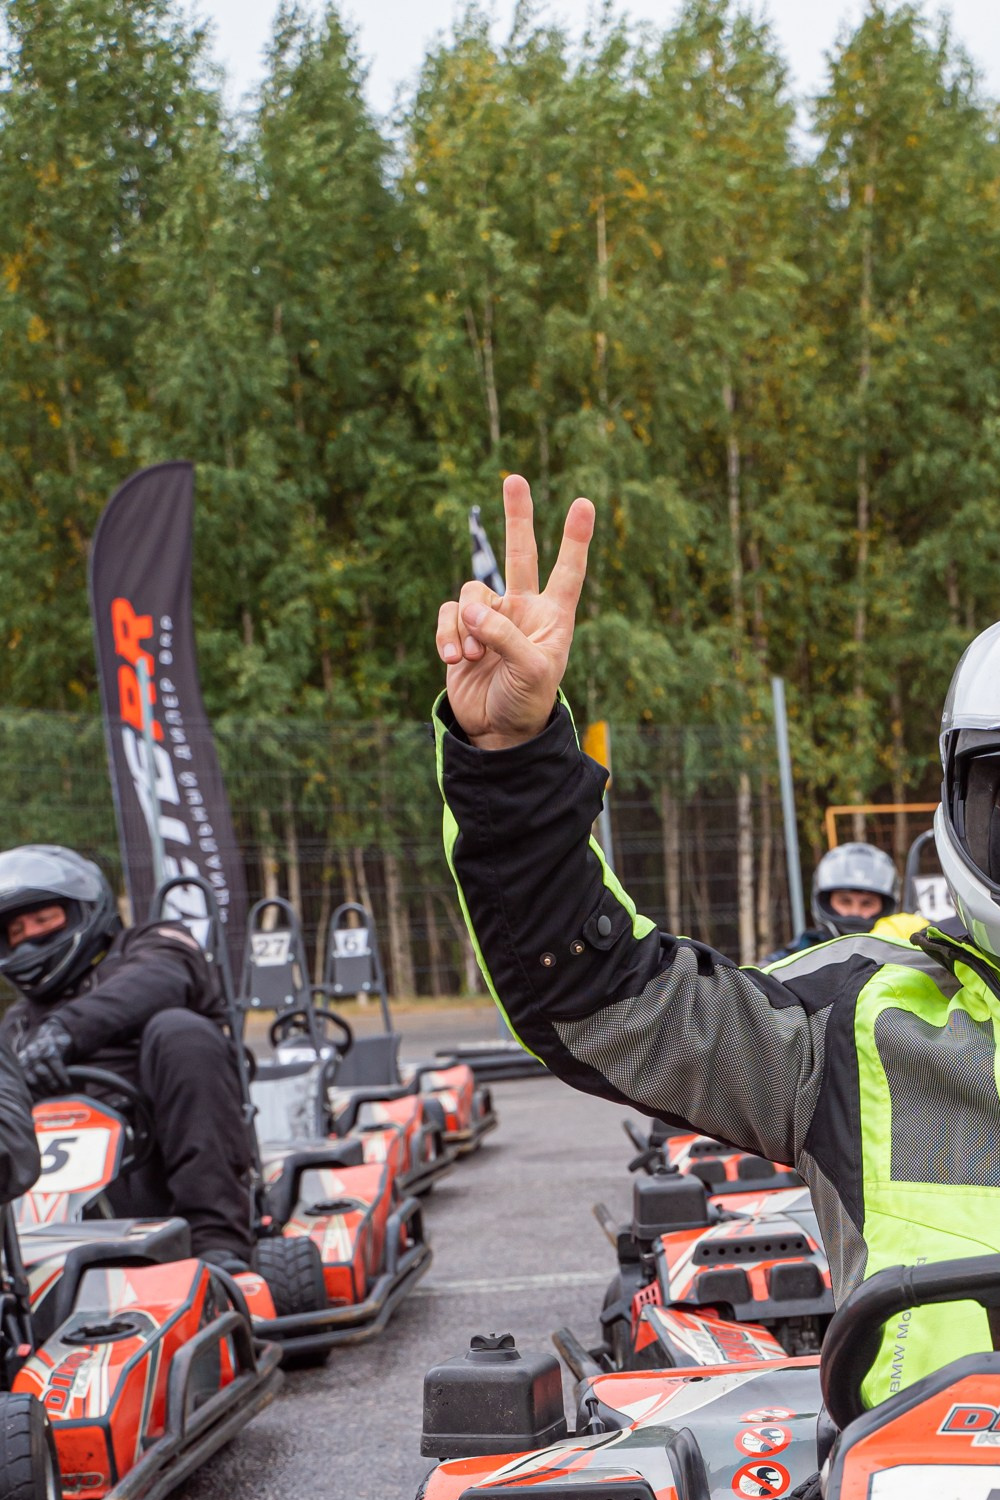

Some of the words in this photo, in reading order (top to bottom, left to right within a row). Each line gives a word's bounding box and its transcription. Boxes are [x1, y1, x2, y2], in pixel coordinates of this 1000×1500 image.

[159, 677, 193, 761] ДИЛЕР
[257, 938, 286, 958] 27
[343, 936, 359, 951] 6
[41, 1136, 79, 1175] 5
[890, 1345, 906, 1393] BMW
